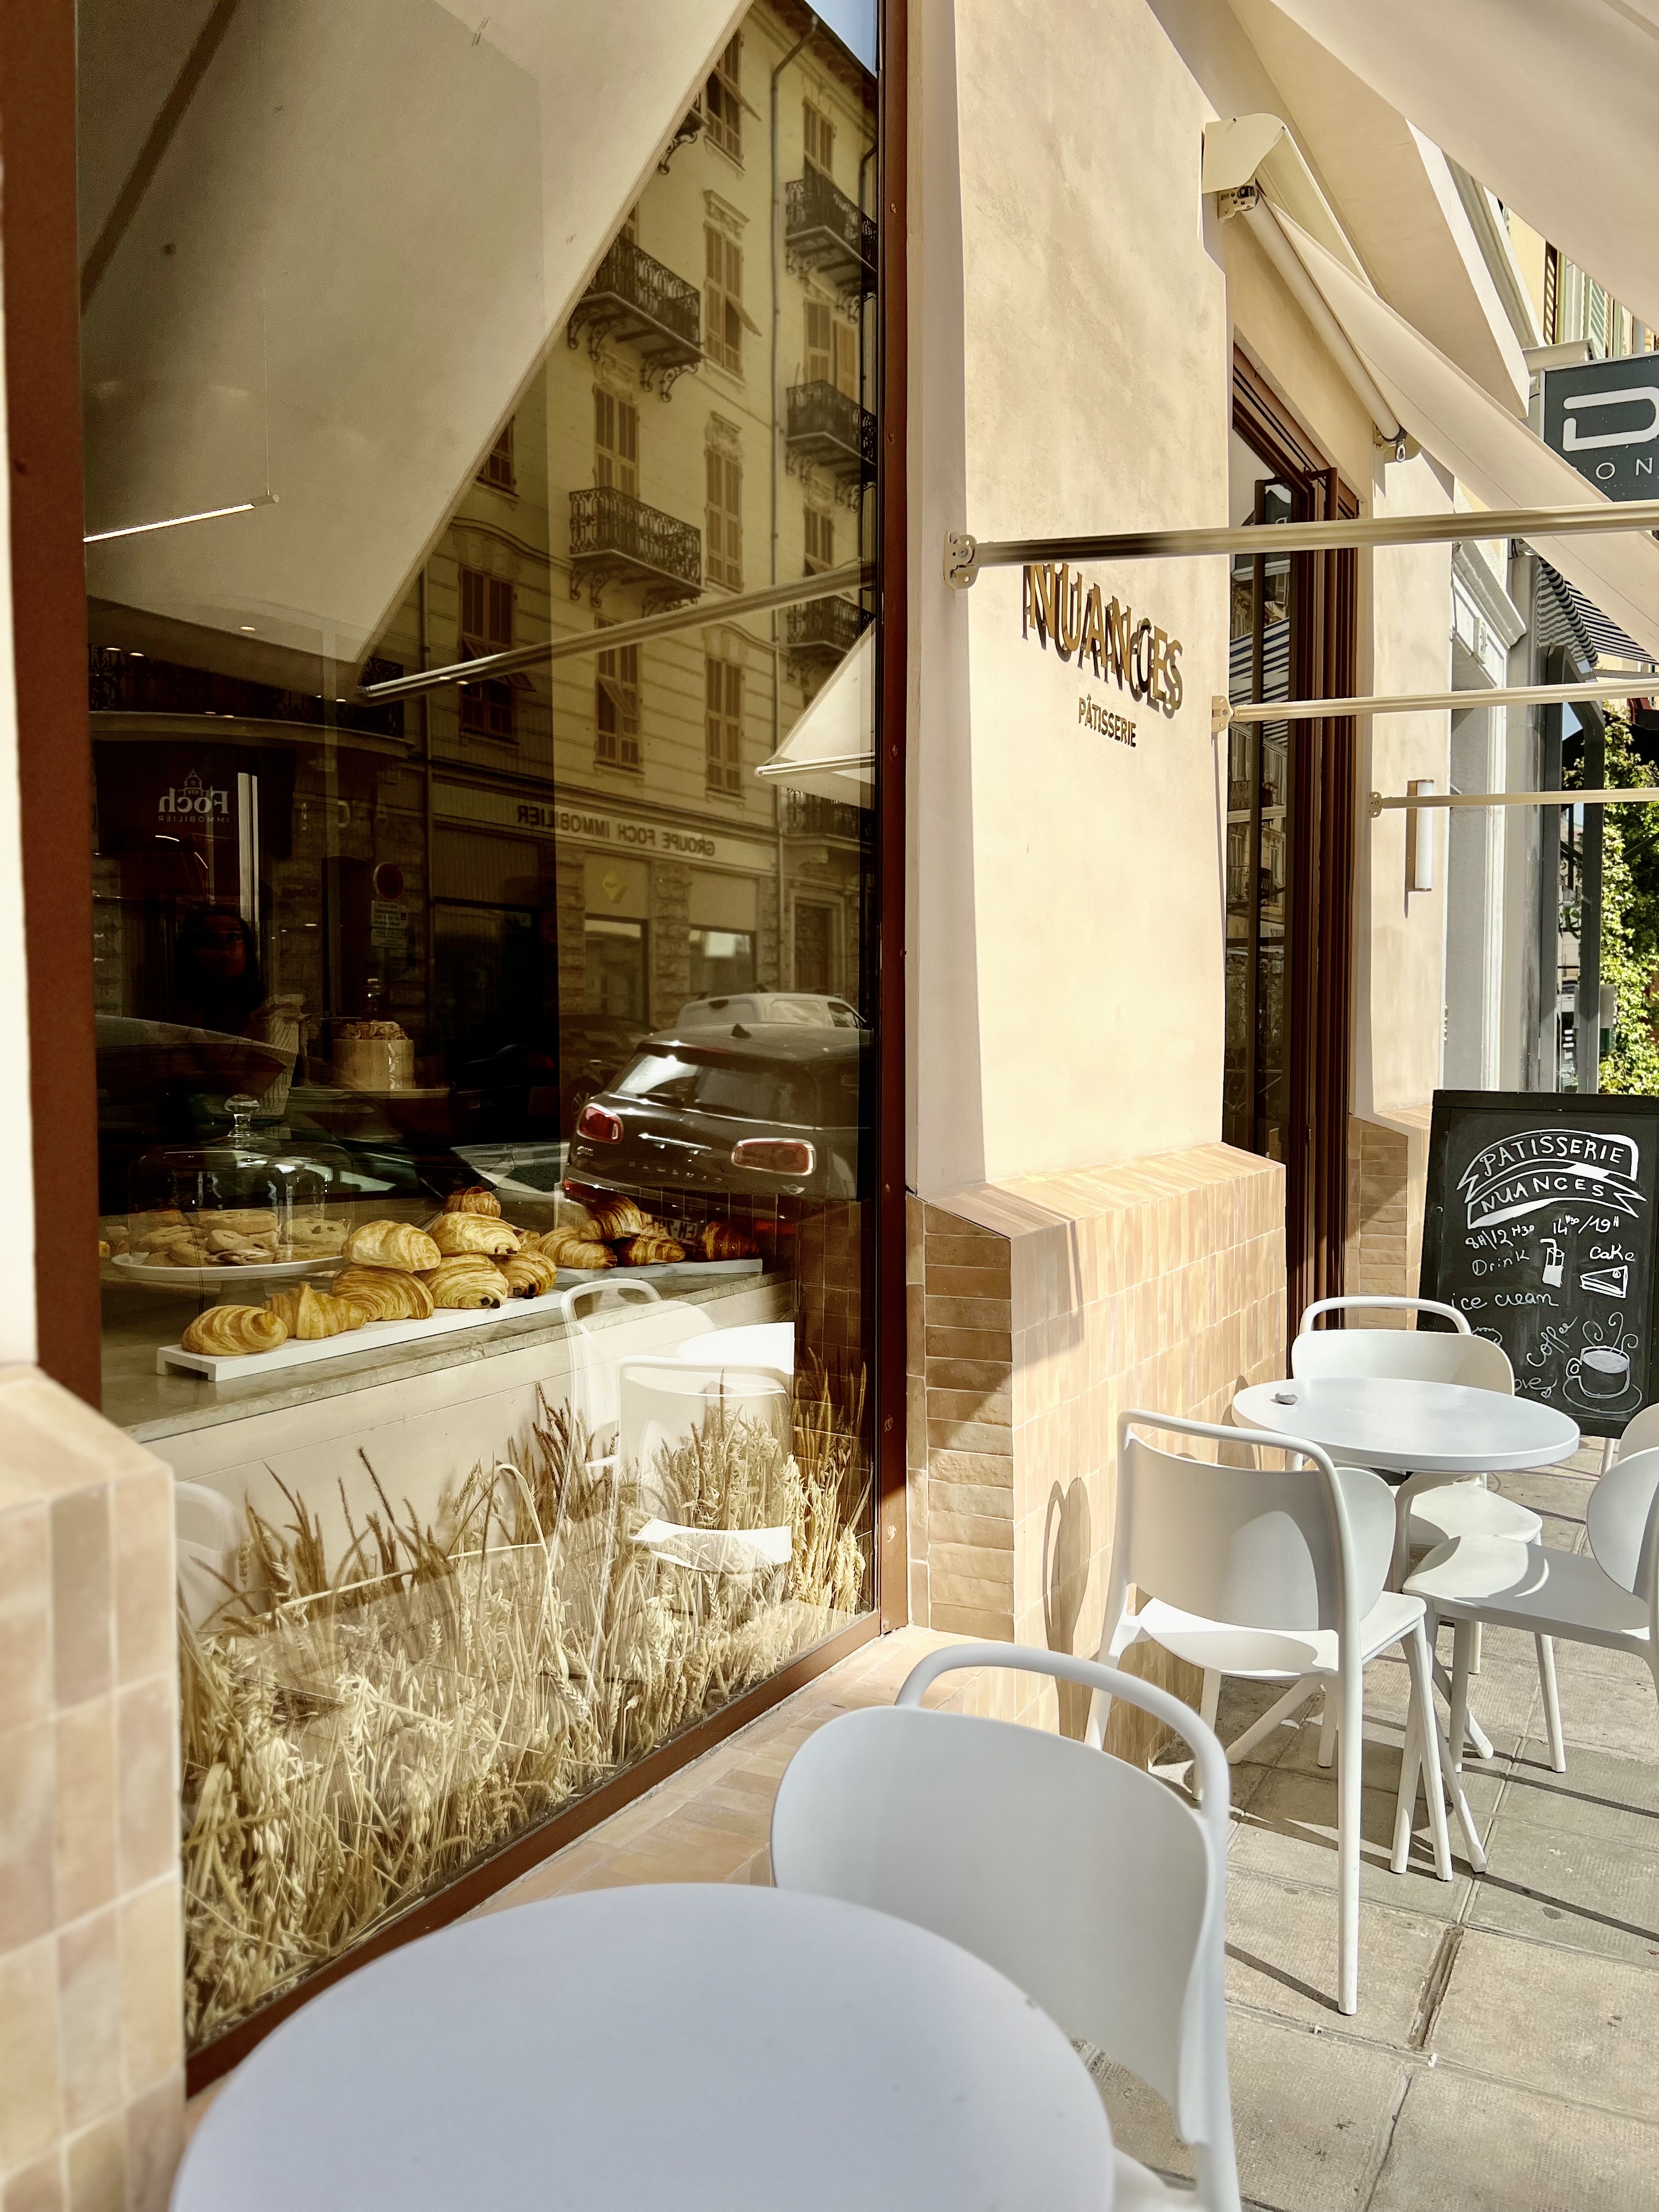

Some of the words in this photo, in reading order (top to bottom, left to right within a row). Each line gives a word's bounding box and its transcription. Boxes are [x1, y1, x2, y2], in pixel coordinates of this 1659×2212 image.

[1024, 563, 1183, 716] NUANCES
[1078, 693, 1137, 748] PÂTISSERIE
[1480, 1136, 1624, 1176] PATISSERIE
[1481, 1176, 1605, 1212] NUANCES
[1451, 1293, 1488, 1310] ice
